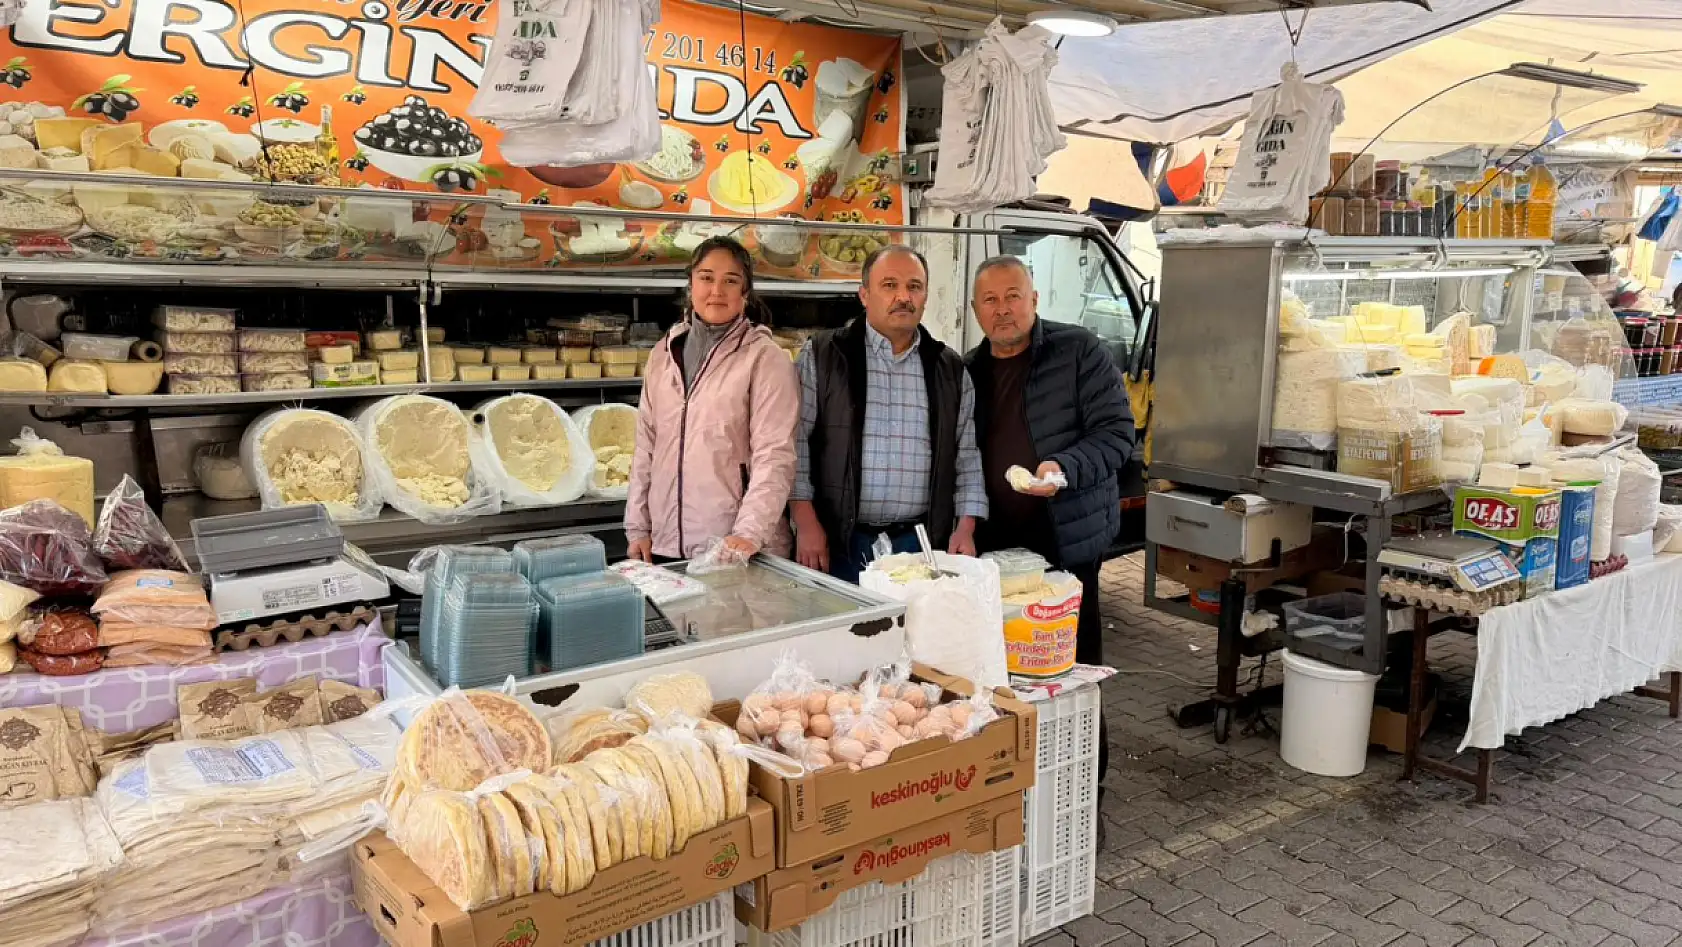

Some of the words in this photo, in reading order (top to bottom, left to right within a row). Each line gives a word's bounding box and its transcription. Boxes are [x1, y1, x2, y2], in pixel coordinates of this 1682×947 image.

[663, 32, 704, 64] 201
[715, 42, 744, 68] 46
[753, 46, 777, 74] 14
[871, 769, 953, 809] keskinoğlu
[876, 832, 951, 867] keskinoğlu
